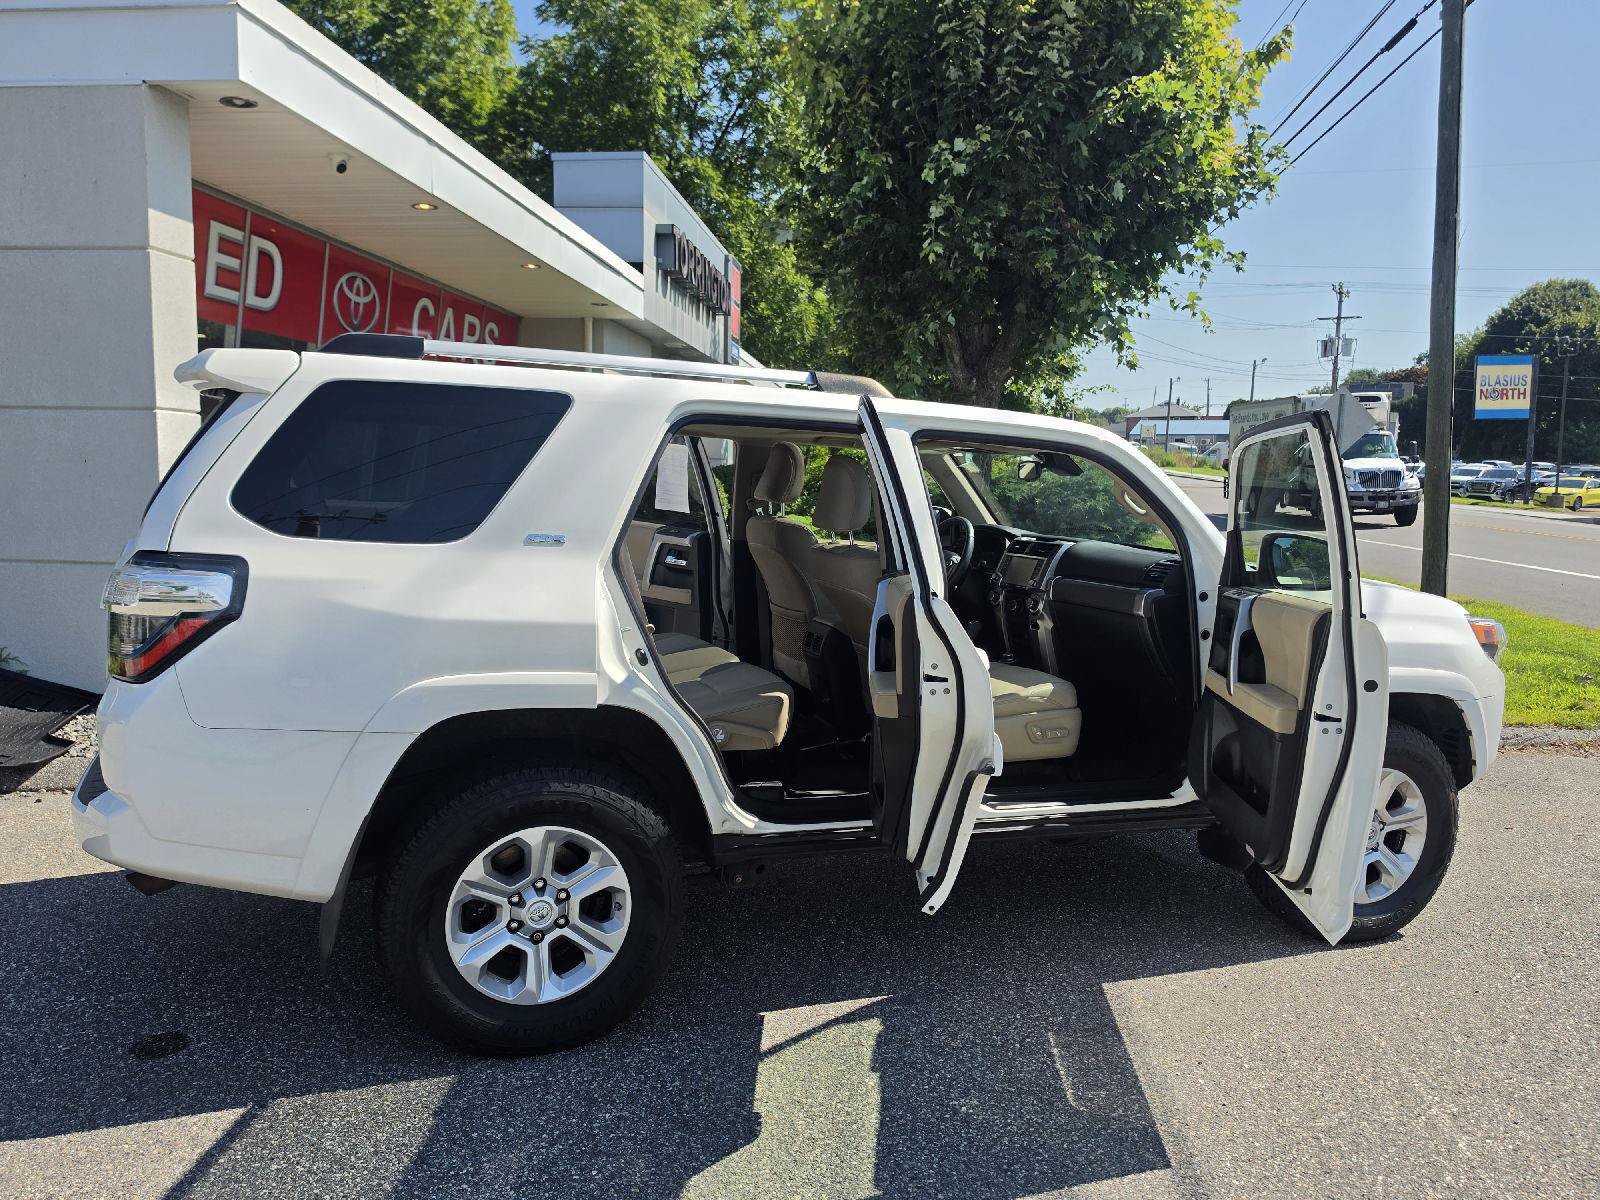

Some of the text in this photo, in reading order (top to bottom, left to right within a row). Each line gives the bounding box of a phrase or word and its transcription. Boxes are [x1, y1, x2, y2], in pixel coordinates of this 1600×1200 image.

[668, 223, 732, 316] TORRINGTON
[411, 297, 500, 350] CARS
[1479, 387, 1527, 401] NORTH
[1480, 373, 1528, 388] BLASIUS
